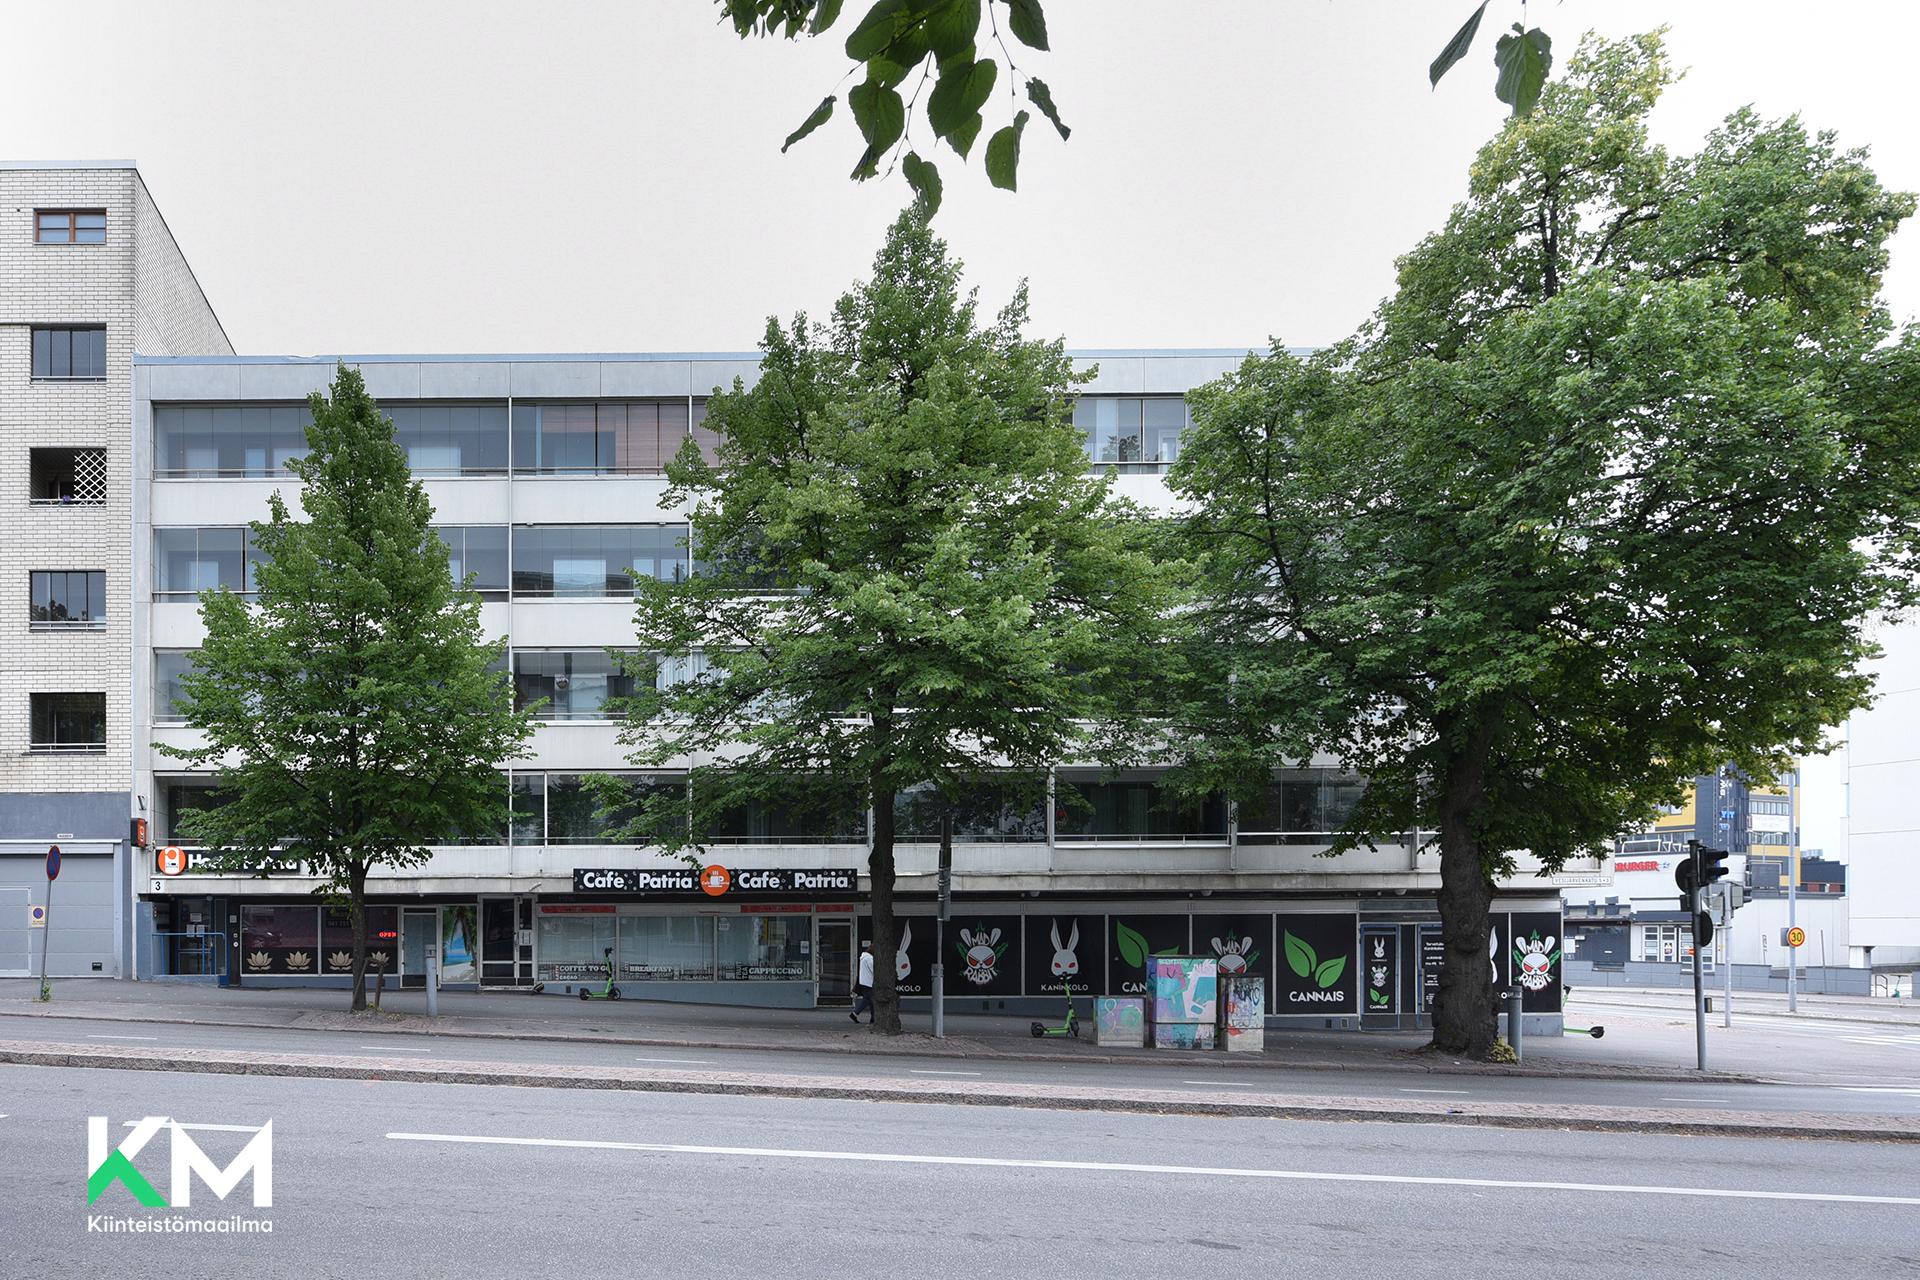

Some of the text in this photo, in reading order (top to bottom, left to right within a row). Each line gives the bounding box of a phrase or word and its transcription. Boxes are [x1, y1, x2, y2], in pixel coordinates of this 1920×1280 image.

[155, 881, 161, 891] 3
[583, 871, 693, 889] Cafe Patria
[738, 871, 848, 889] Cafe Patria
[971, 932, 991, 946] MAD
[1791, 932, 1802, 942] 30
[1222, 938, 1242, 954] MAD
[1526, 940, 1545, 954] MAD
[748, 967, 803, 975] CAPPUCCINO
[963, 967, 998, 985] RABBIT
[1122, 981, 1147, 993] CAN
[1518, 973, 1552, 990] RABBIT
[1289, 990, 1345, 1002] CANNAIS
